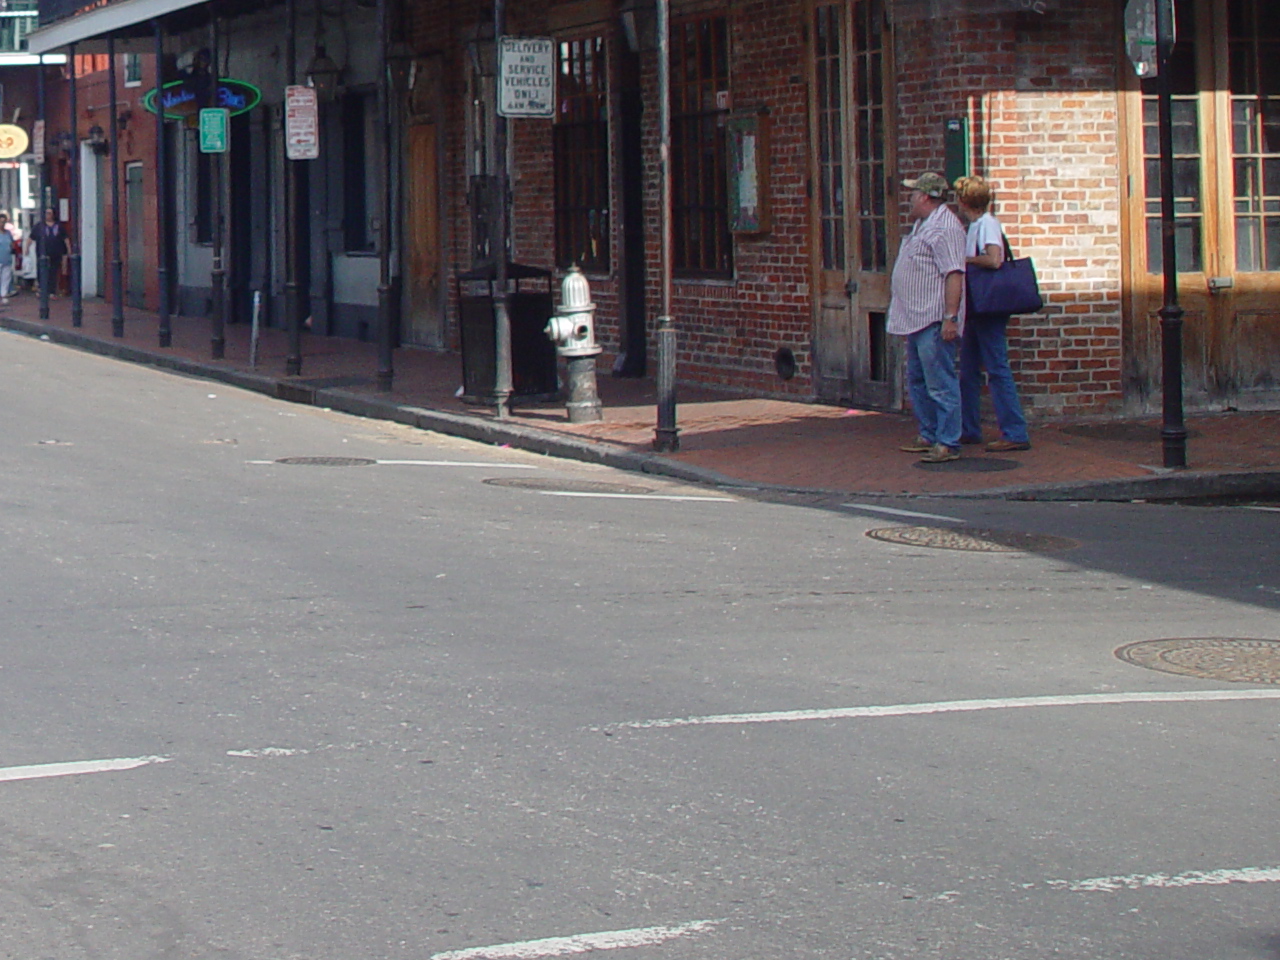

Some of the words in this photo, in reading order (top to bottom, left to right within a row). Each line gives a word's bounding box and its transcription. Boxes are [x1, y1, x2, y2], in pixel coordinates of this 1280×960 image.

[504, 42, 550, 54] DELIVERY
[519, 55, 536, 63] AND
[508, 65, 547, 75] SERVICE
[504, 76, 551, 88] VEHICLES
